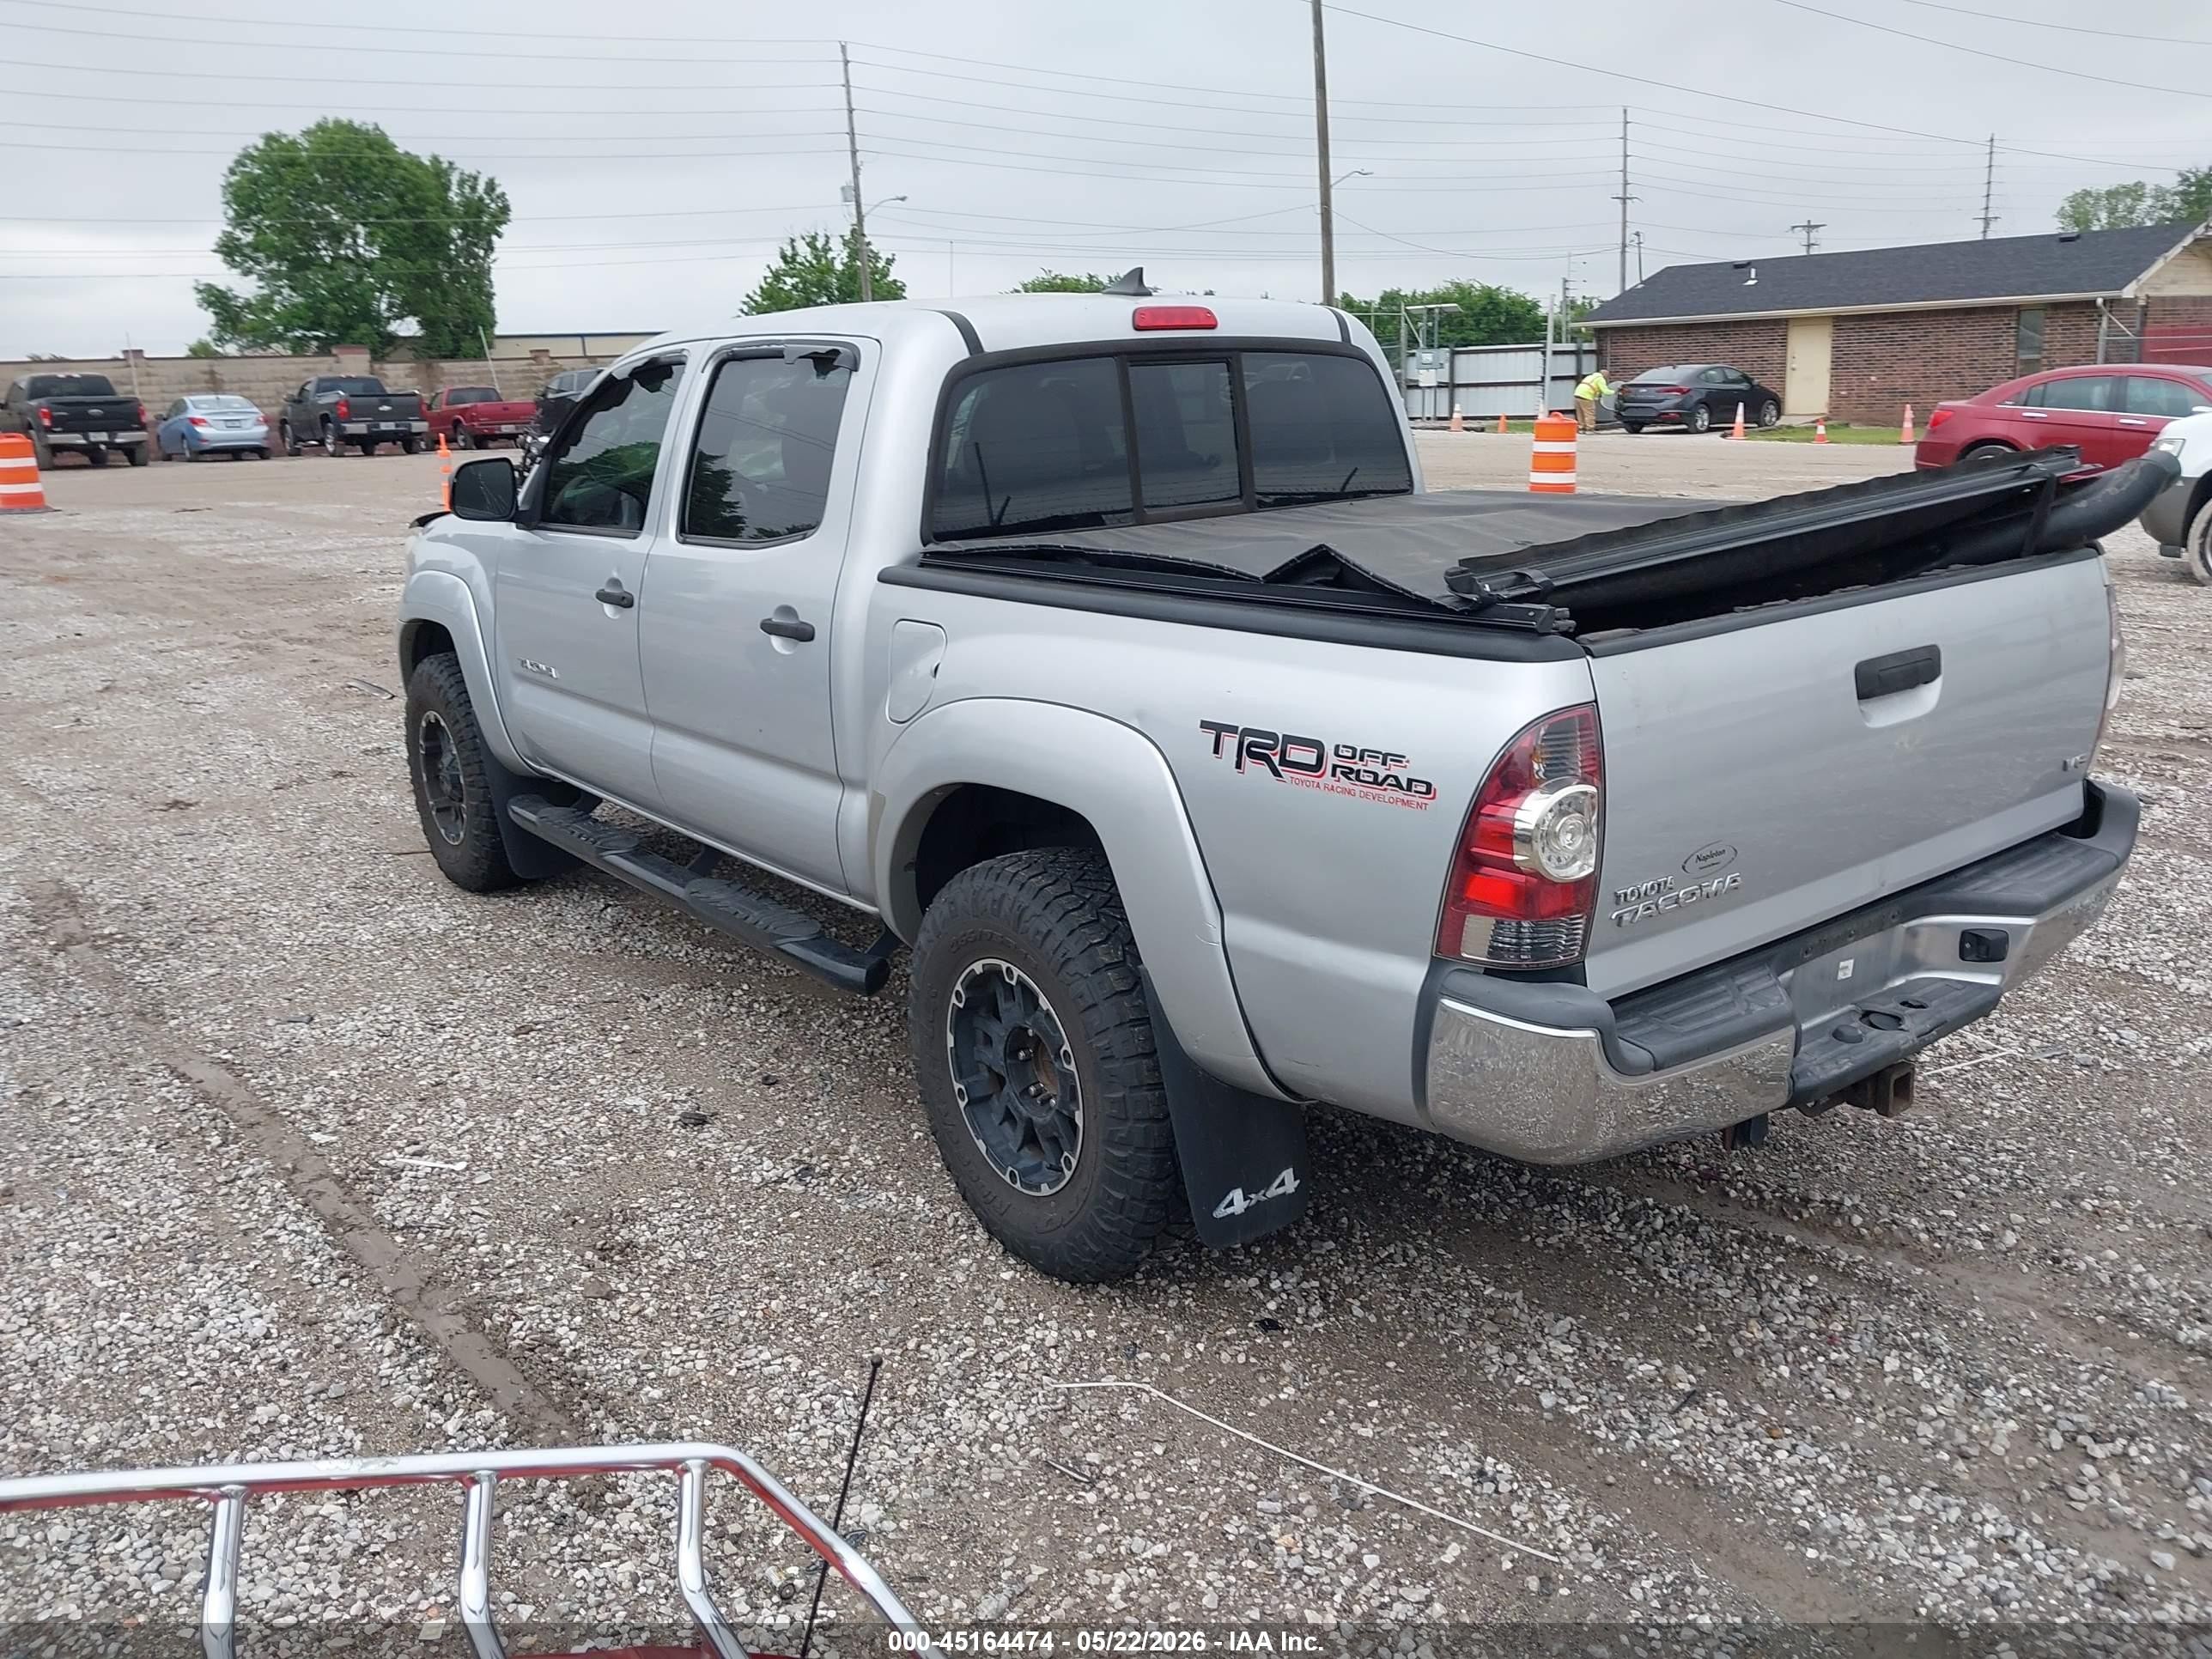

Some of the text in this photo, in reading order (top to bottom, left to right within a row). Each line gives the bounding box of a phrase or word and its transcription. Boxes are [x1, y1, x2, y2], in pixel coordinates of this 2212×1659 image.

[1200, 720, 1328, 782] TRD
[1334, 744, 1410, 769] OFF
[1289, 776, 1428, 811] TOYOTA RACING DEVELOPMENT
[1331, 764, 1436, 799] ROAD
[1610, 872, 1741, 927] TACOMA
[1614, 875, 1675, 905] TOYOTA
